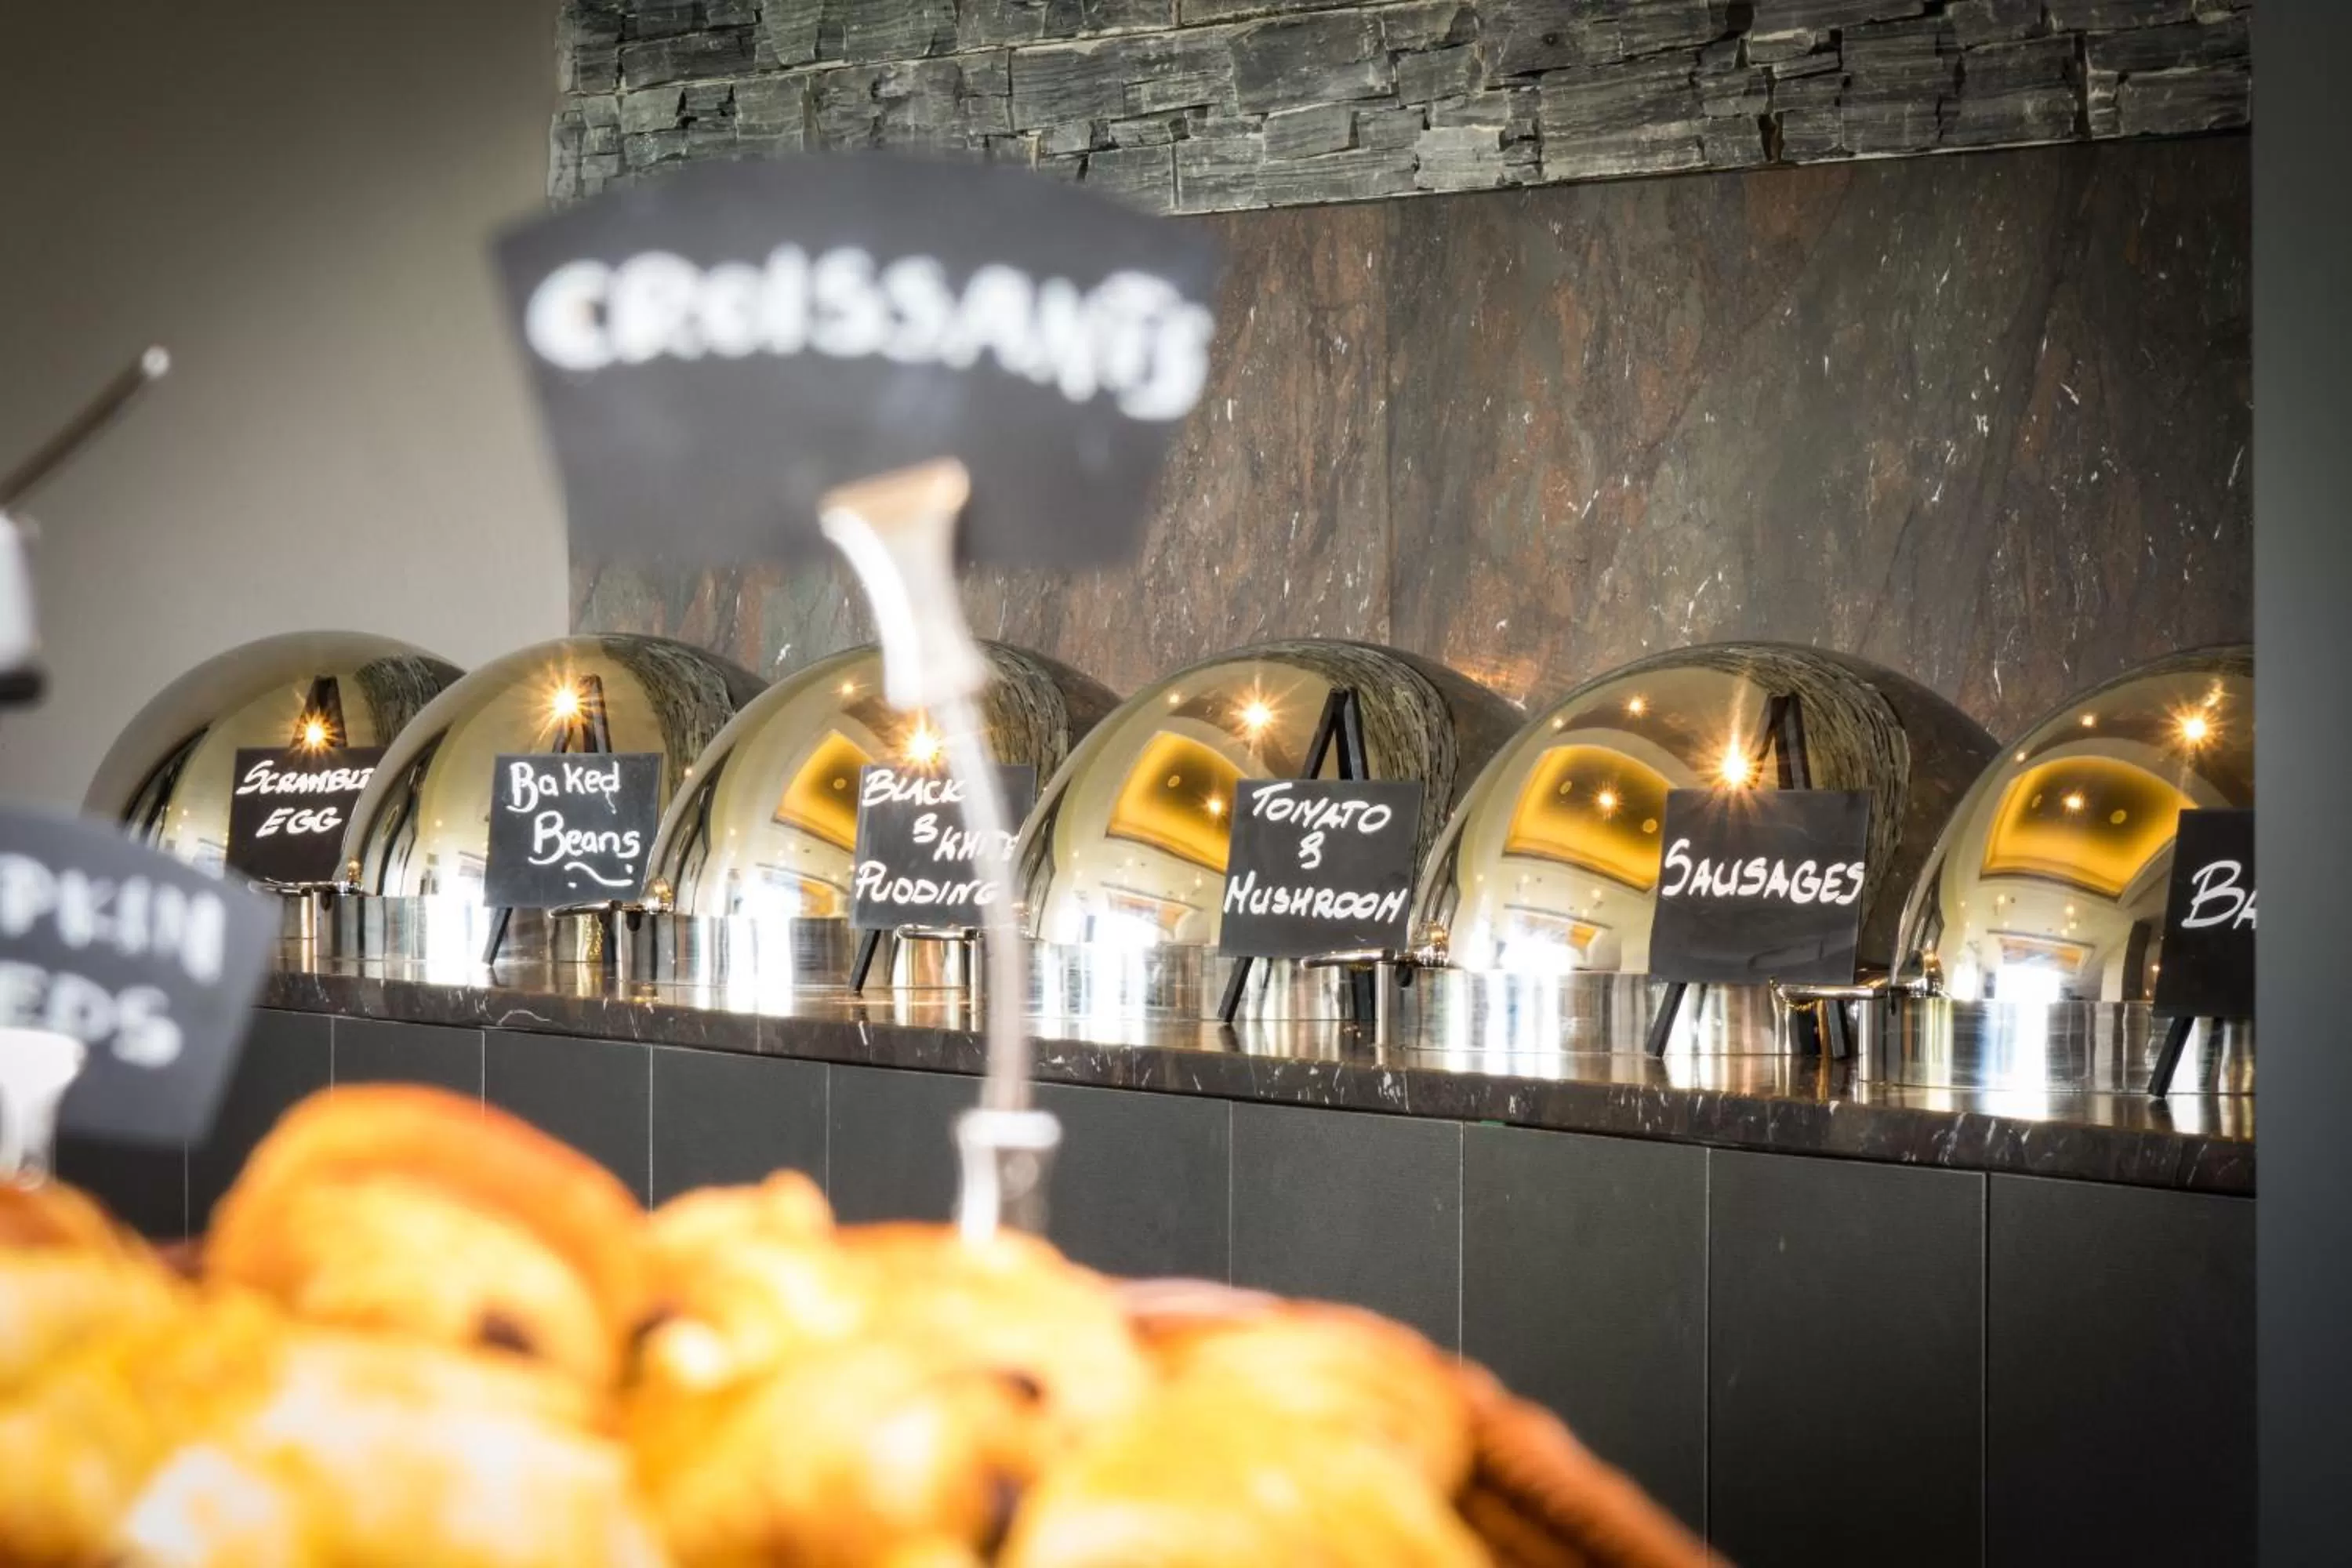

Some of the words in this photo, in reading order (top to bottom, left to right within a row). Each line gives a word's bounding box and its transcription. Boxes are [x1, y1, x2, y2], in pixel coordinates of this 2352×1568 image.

[506, 760, 622, 814] Baked
[862, 769, 967, 807] BLACK
[1252, 782, 1392, 834] TOMATO
[256, 807, 343, 838] EGG
[528, 810, 641, 865] Beans
[855, 861, 1000, 906] PUDDING
[1223, 870, 1409, 924] MUSHROOM
[1661, 837, 1865, 905] SAUSAGES
